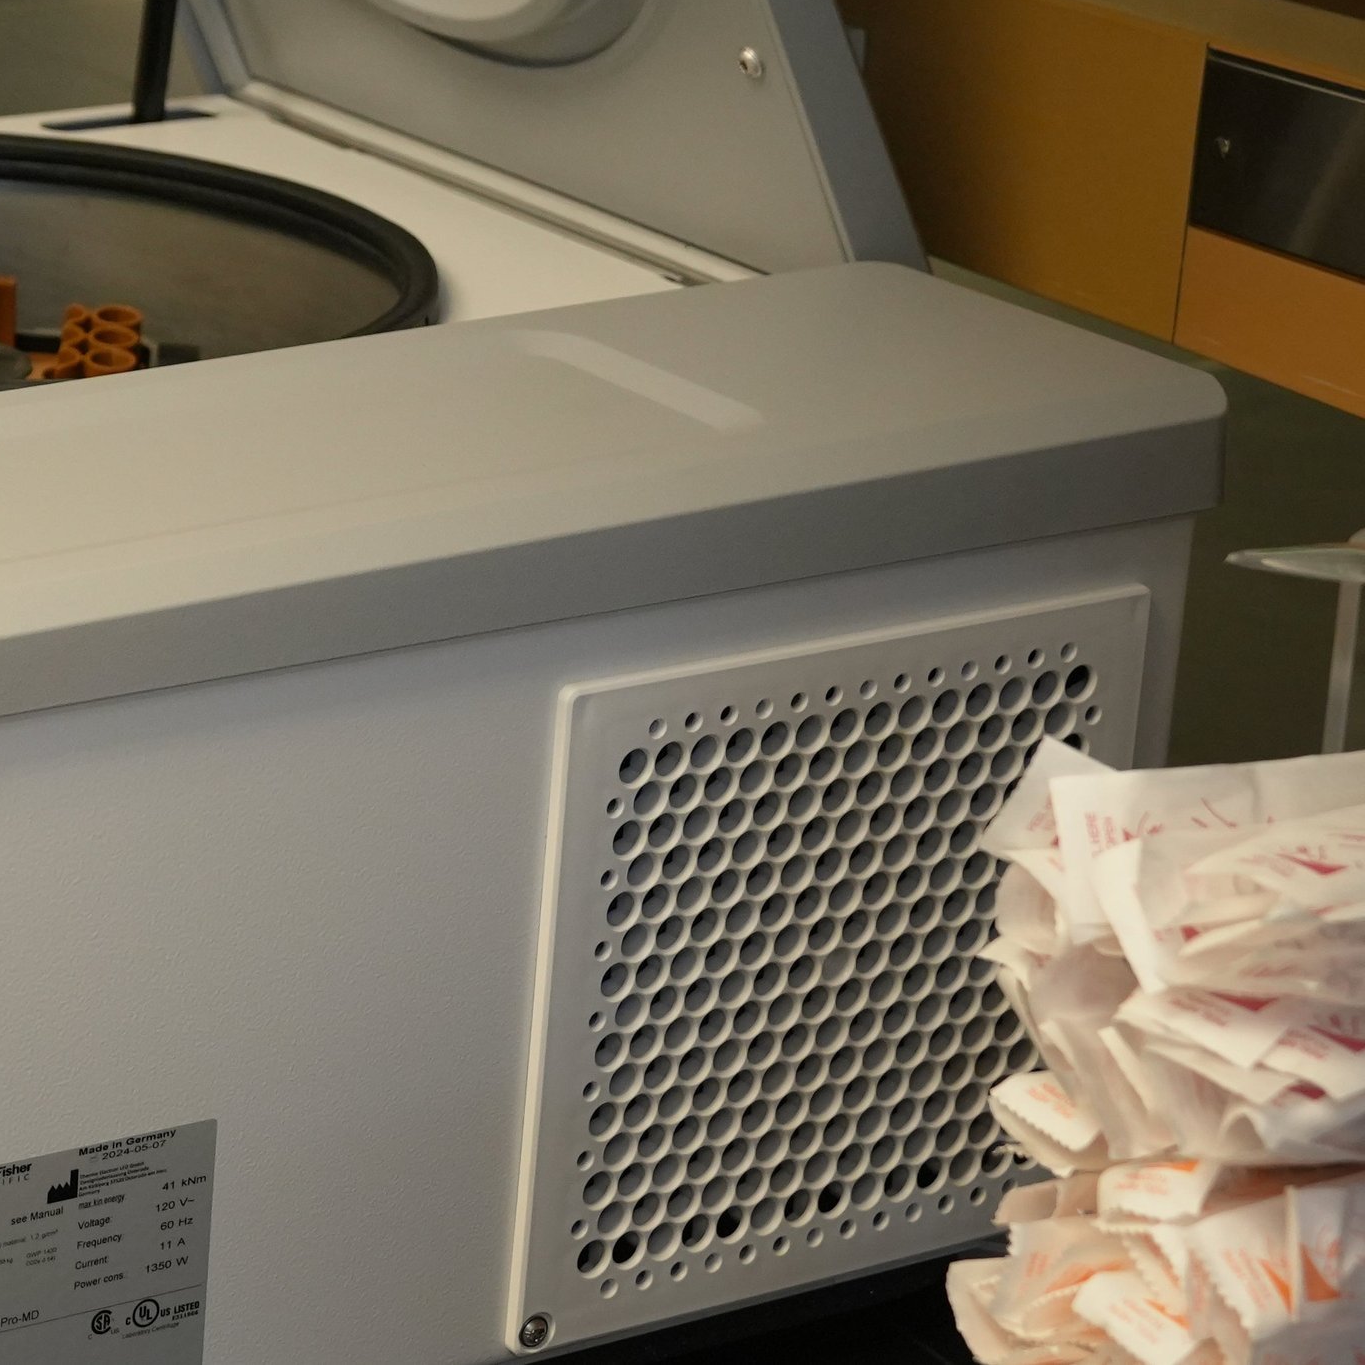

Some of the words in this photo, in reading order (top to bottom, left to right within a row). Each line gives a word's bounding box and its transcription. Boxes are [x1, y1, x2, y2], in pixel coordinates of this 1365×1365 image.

[78, 1144, 109, 1156] Made
[112, 1141, 123, 1150] in
[126, 1129, 177, 1146] Germany
[102, 1139, 167, 1161] 2024-05-07
[162, 1180, 175, 1190] 41
[181, 1175, 207, 1187] kNm
[156, 1200, 176, 1213] 120
[10, 1216, 28, 1226] see
[29, 1207, 64, 1222] Manual
[160, 1220, 175, 1231] 60
[178, 1217, 194, 1227] Hz
[160, 1240, 172, 1250] 11
[177, 1237, 186, 1247] A
[146, 1260, 172, 1274] 1350
[176, 1255, 189, 1266] W
[74, 1277, 101, 1290] Power
[160, 1307, 171, 1318] US
[174, 1301, 200, 1314] LISTED
[0, 1310, 40, 1328] Pro-MD
